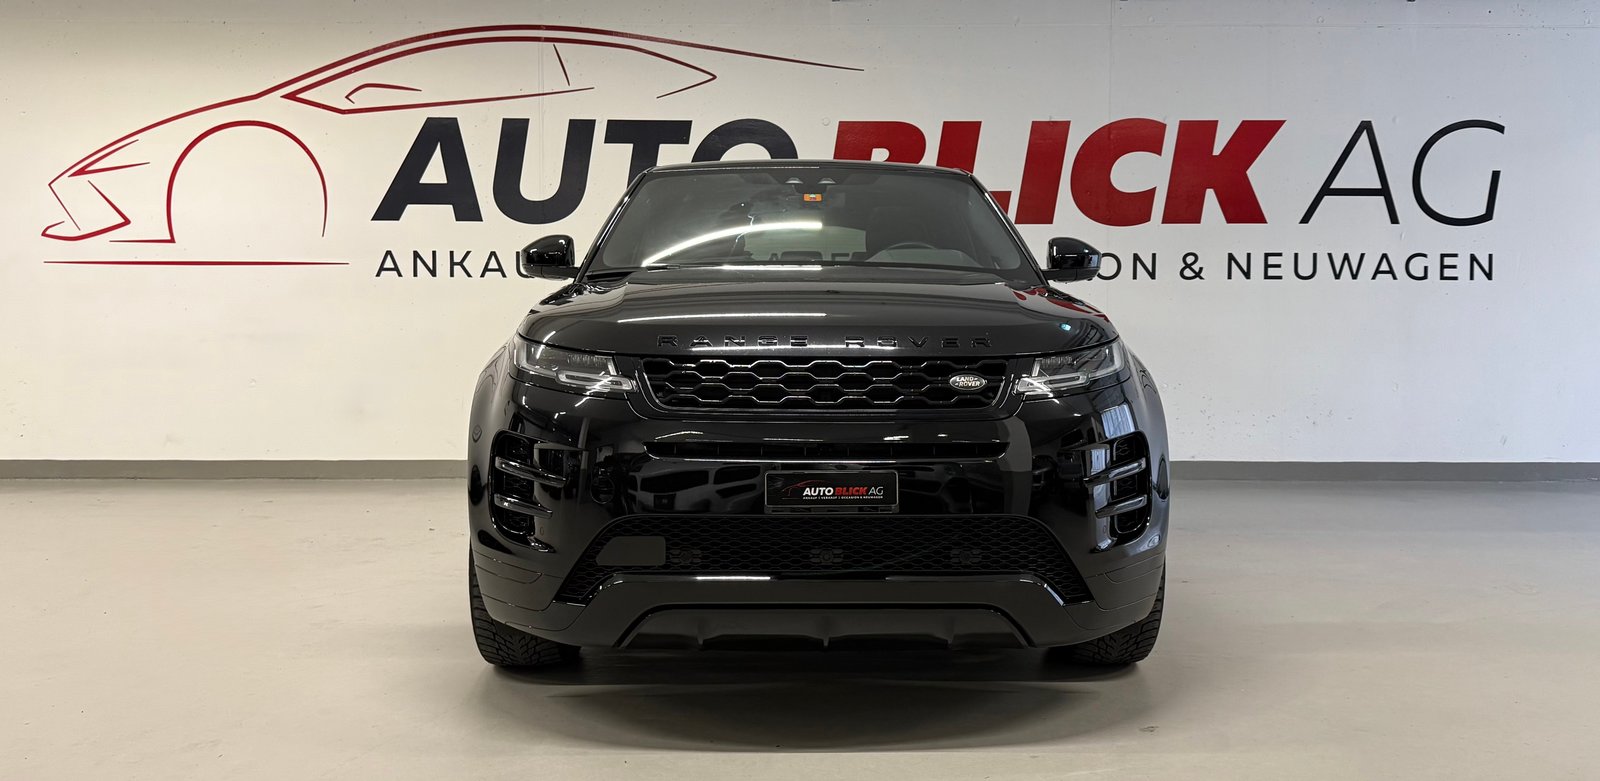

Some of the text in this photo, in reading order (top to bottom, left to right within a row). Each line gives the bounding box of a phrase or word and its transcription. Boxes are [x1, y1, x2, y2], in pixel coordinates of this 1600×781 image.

[1299, 119, 1506, 227] AG
[1179, 251, 1206, 281] &
[1226, 252, 1495, 281] NEUWAGEN
[657, 335, 993, 348] RANGE ROVER
[802, 486, 884, 496] AUTO BLICK AG
